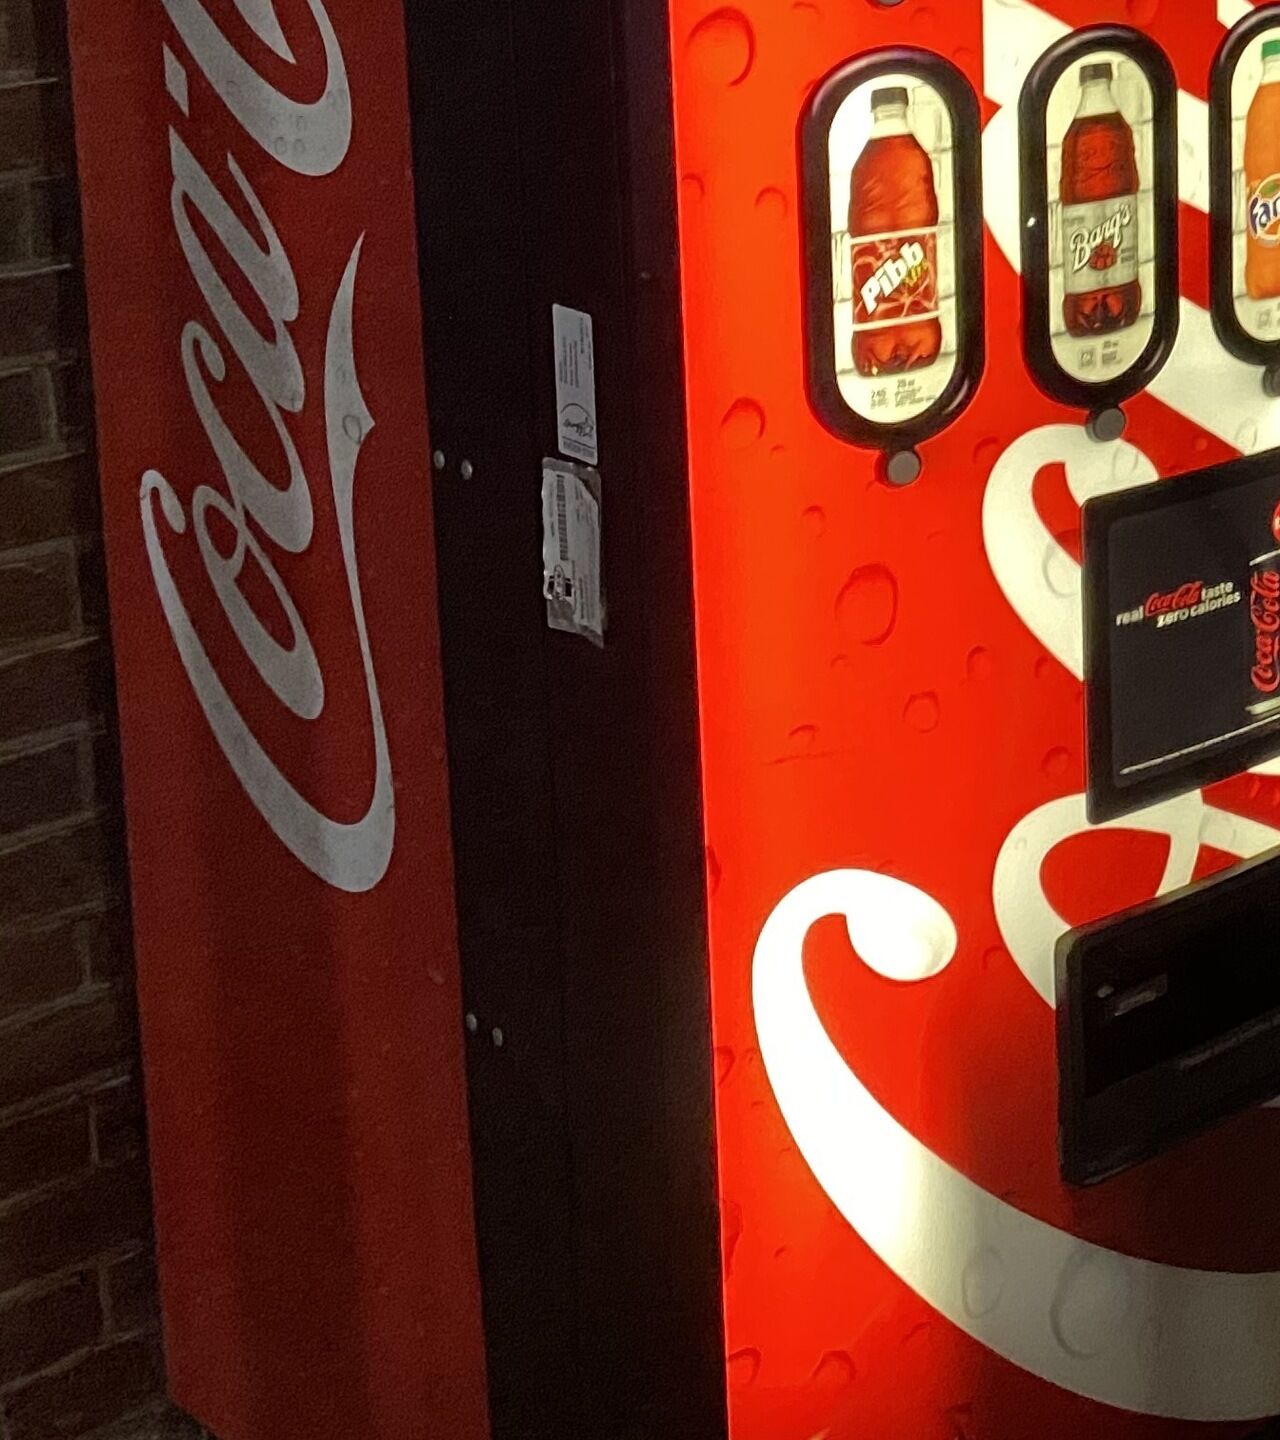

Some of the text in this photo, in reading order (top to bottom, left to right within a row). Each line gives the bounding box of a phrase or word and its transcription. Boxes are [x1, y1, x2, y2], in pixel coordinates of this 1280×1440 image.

[1070, 204, 1131, 273] Barq's
[861, 242, 924, 315] Pibb
[1116, 581, 1234, 626] real Coca-Cola taste
[1156, 592, 1241, 628] zero calories
[1251, 570, 1280, 692] Coca-Cola
